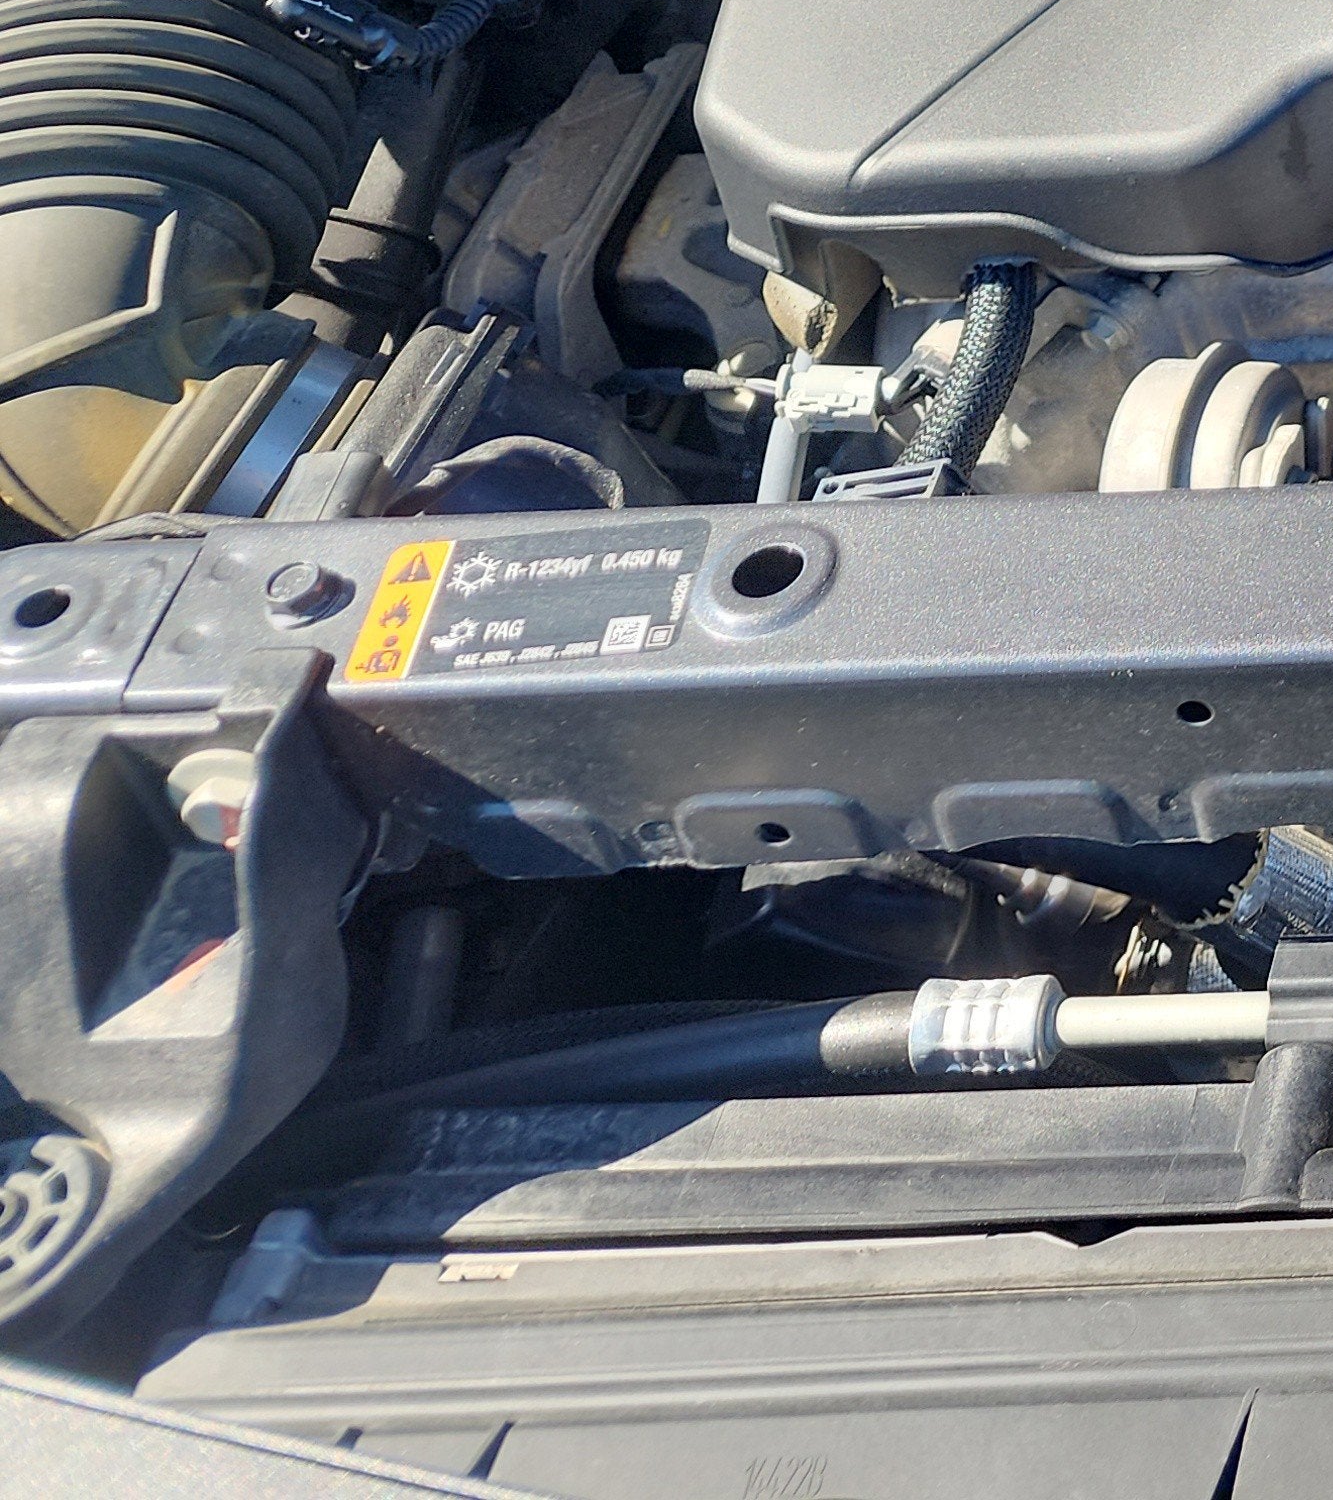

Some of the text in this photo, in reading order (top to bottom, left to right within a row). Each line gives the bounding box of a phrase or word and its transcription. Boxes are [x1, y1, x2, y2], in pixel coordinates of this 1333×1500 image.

[504, 553, 596, 581] R-1234yf
[656, 547, 684, 571] kg
[483, 618, 526, 643] PAG
[453, 651, 481, 669] SAE
